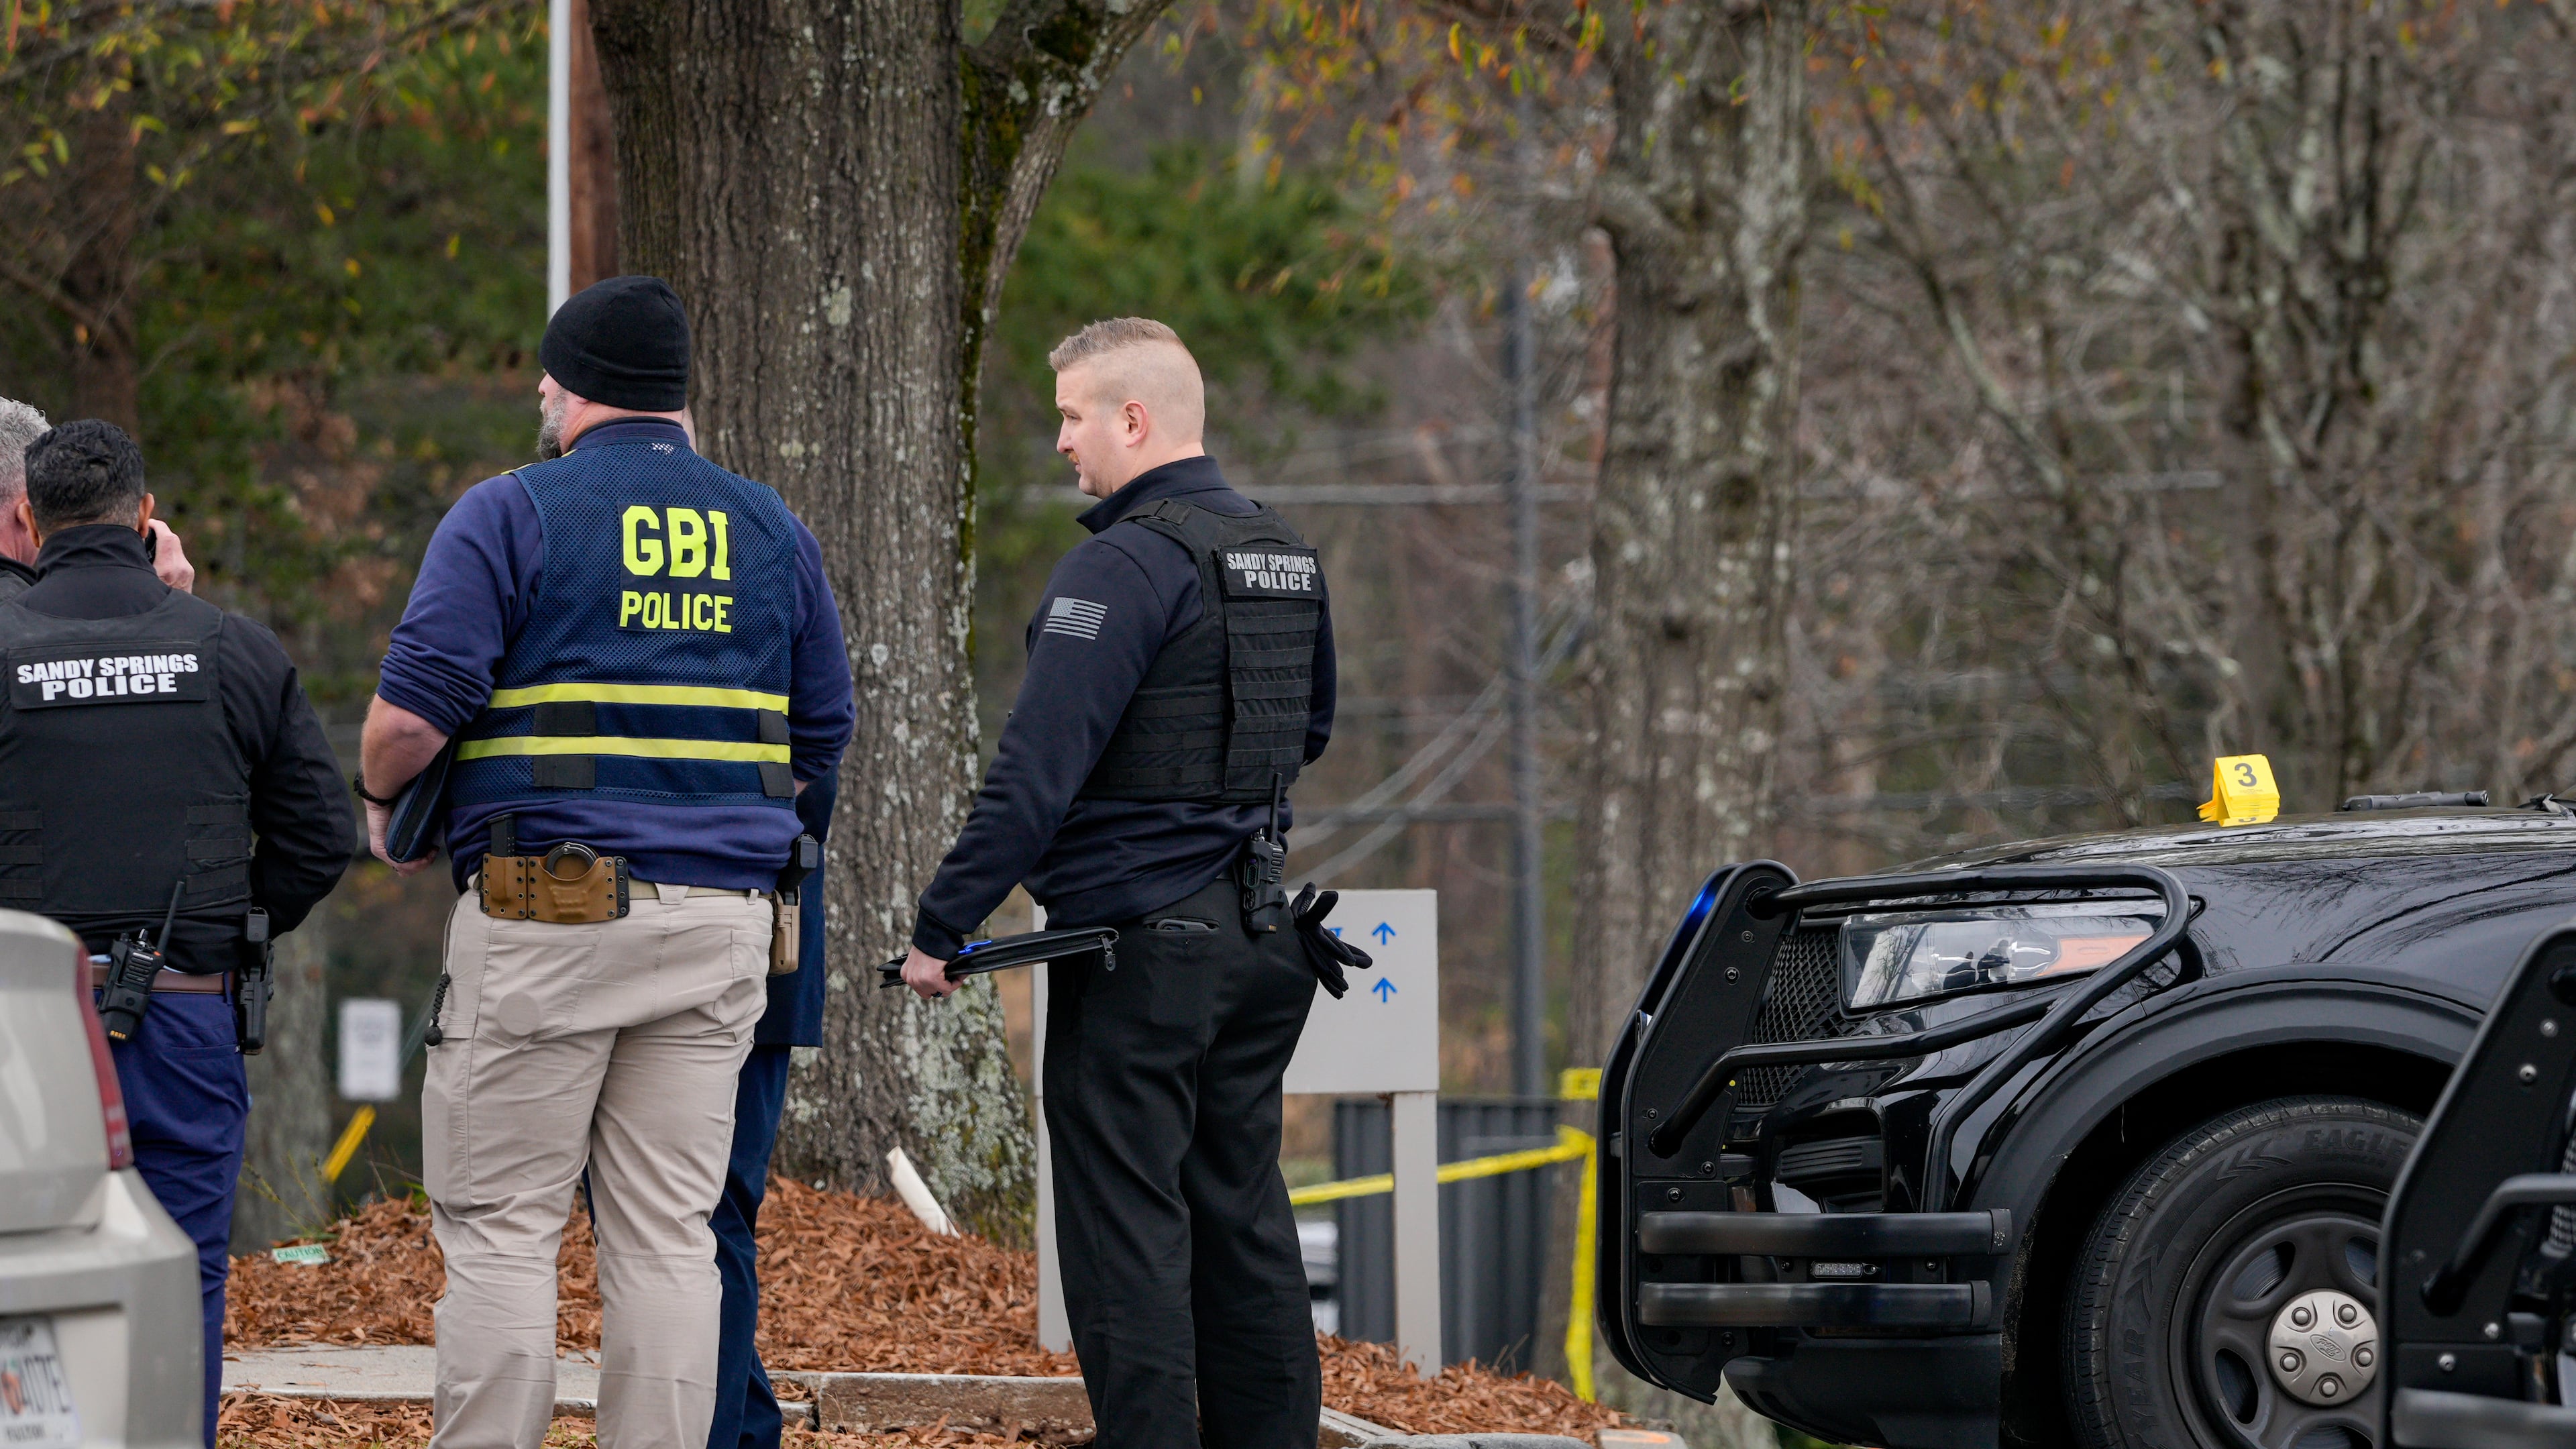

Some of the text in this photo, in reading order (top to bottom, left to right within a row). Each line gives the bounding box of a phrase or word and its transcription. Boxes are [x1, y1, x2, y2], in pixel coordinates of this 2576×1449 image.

[623, 505, 730, 580] GBI
[1226, 552, 1316, 574] SANDY SPRINGS
[1244, 571, 1311, 591] POLICE
[619, 590, 733, 633] POLICE
[17, 653, 199, 684] SANDY SPRINGS
[42, 673, 177, 701] POLICE
[2235, 763, 2257, 787] 3
[2303, 1129, 2410, 1159] EAGLE
[277, 1246, 322, 1258] CAUTION
